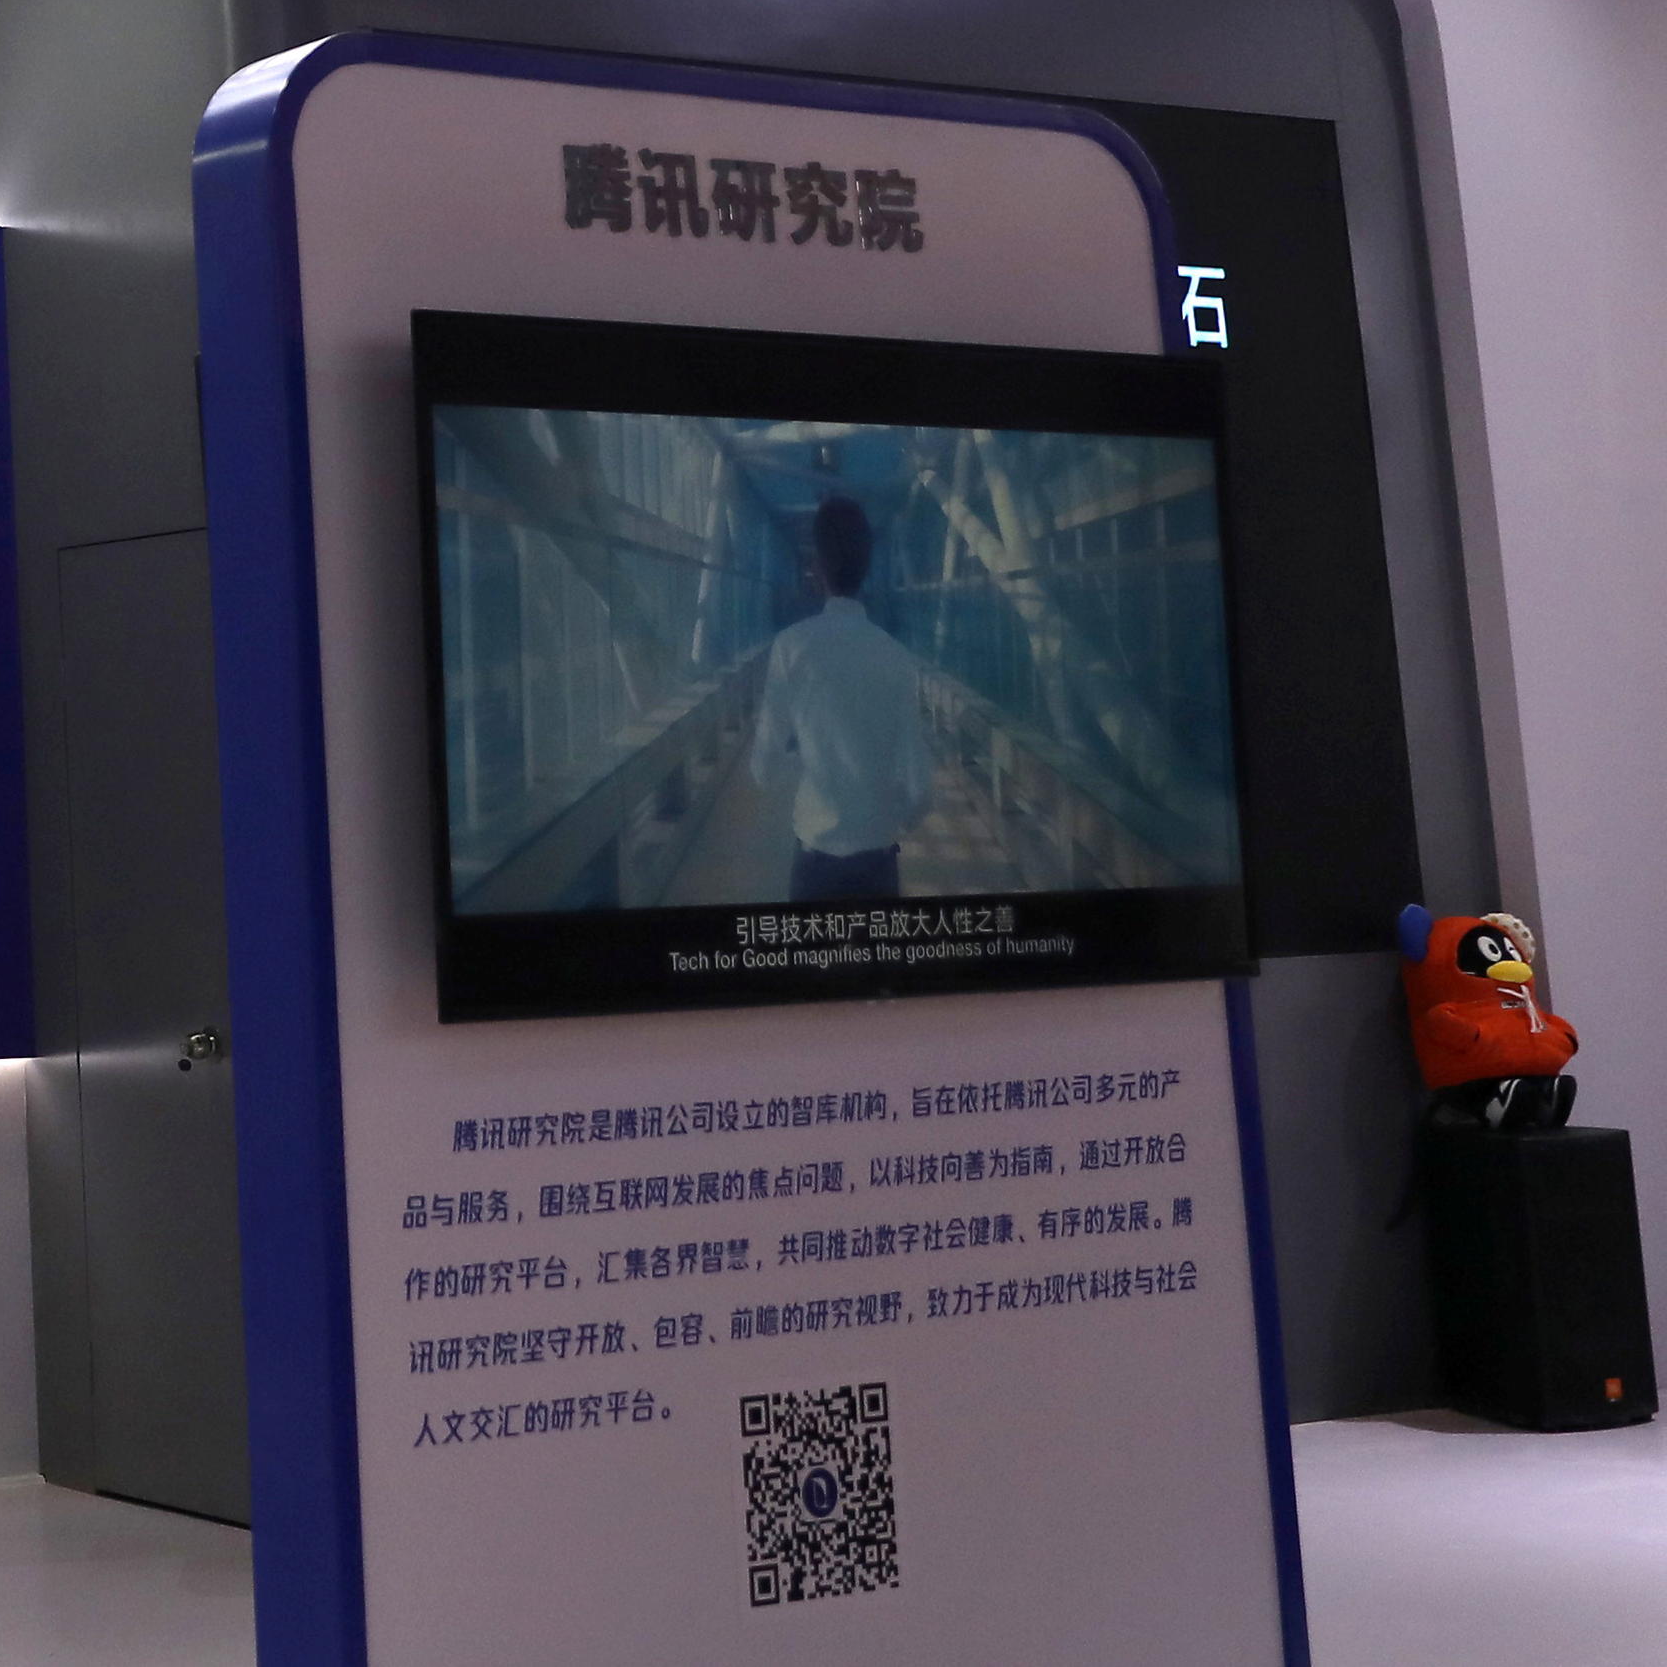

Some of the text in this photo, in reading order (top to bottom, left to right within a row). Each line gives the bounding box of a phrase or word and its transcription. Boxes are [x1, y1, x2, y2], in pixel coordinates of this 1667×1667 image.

[562, 142, 925, 253] 腾讯研究院
[736, 906, 1014, 944] 引导技术和产品放大人性之善
[670, 935, 1075, 971] Tech for Good magnifies the goodness of humanity
[413, 1388, 671, 1448] 人文交汇的研究平台。
